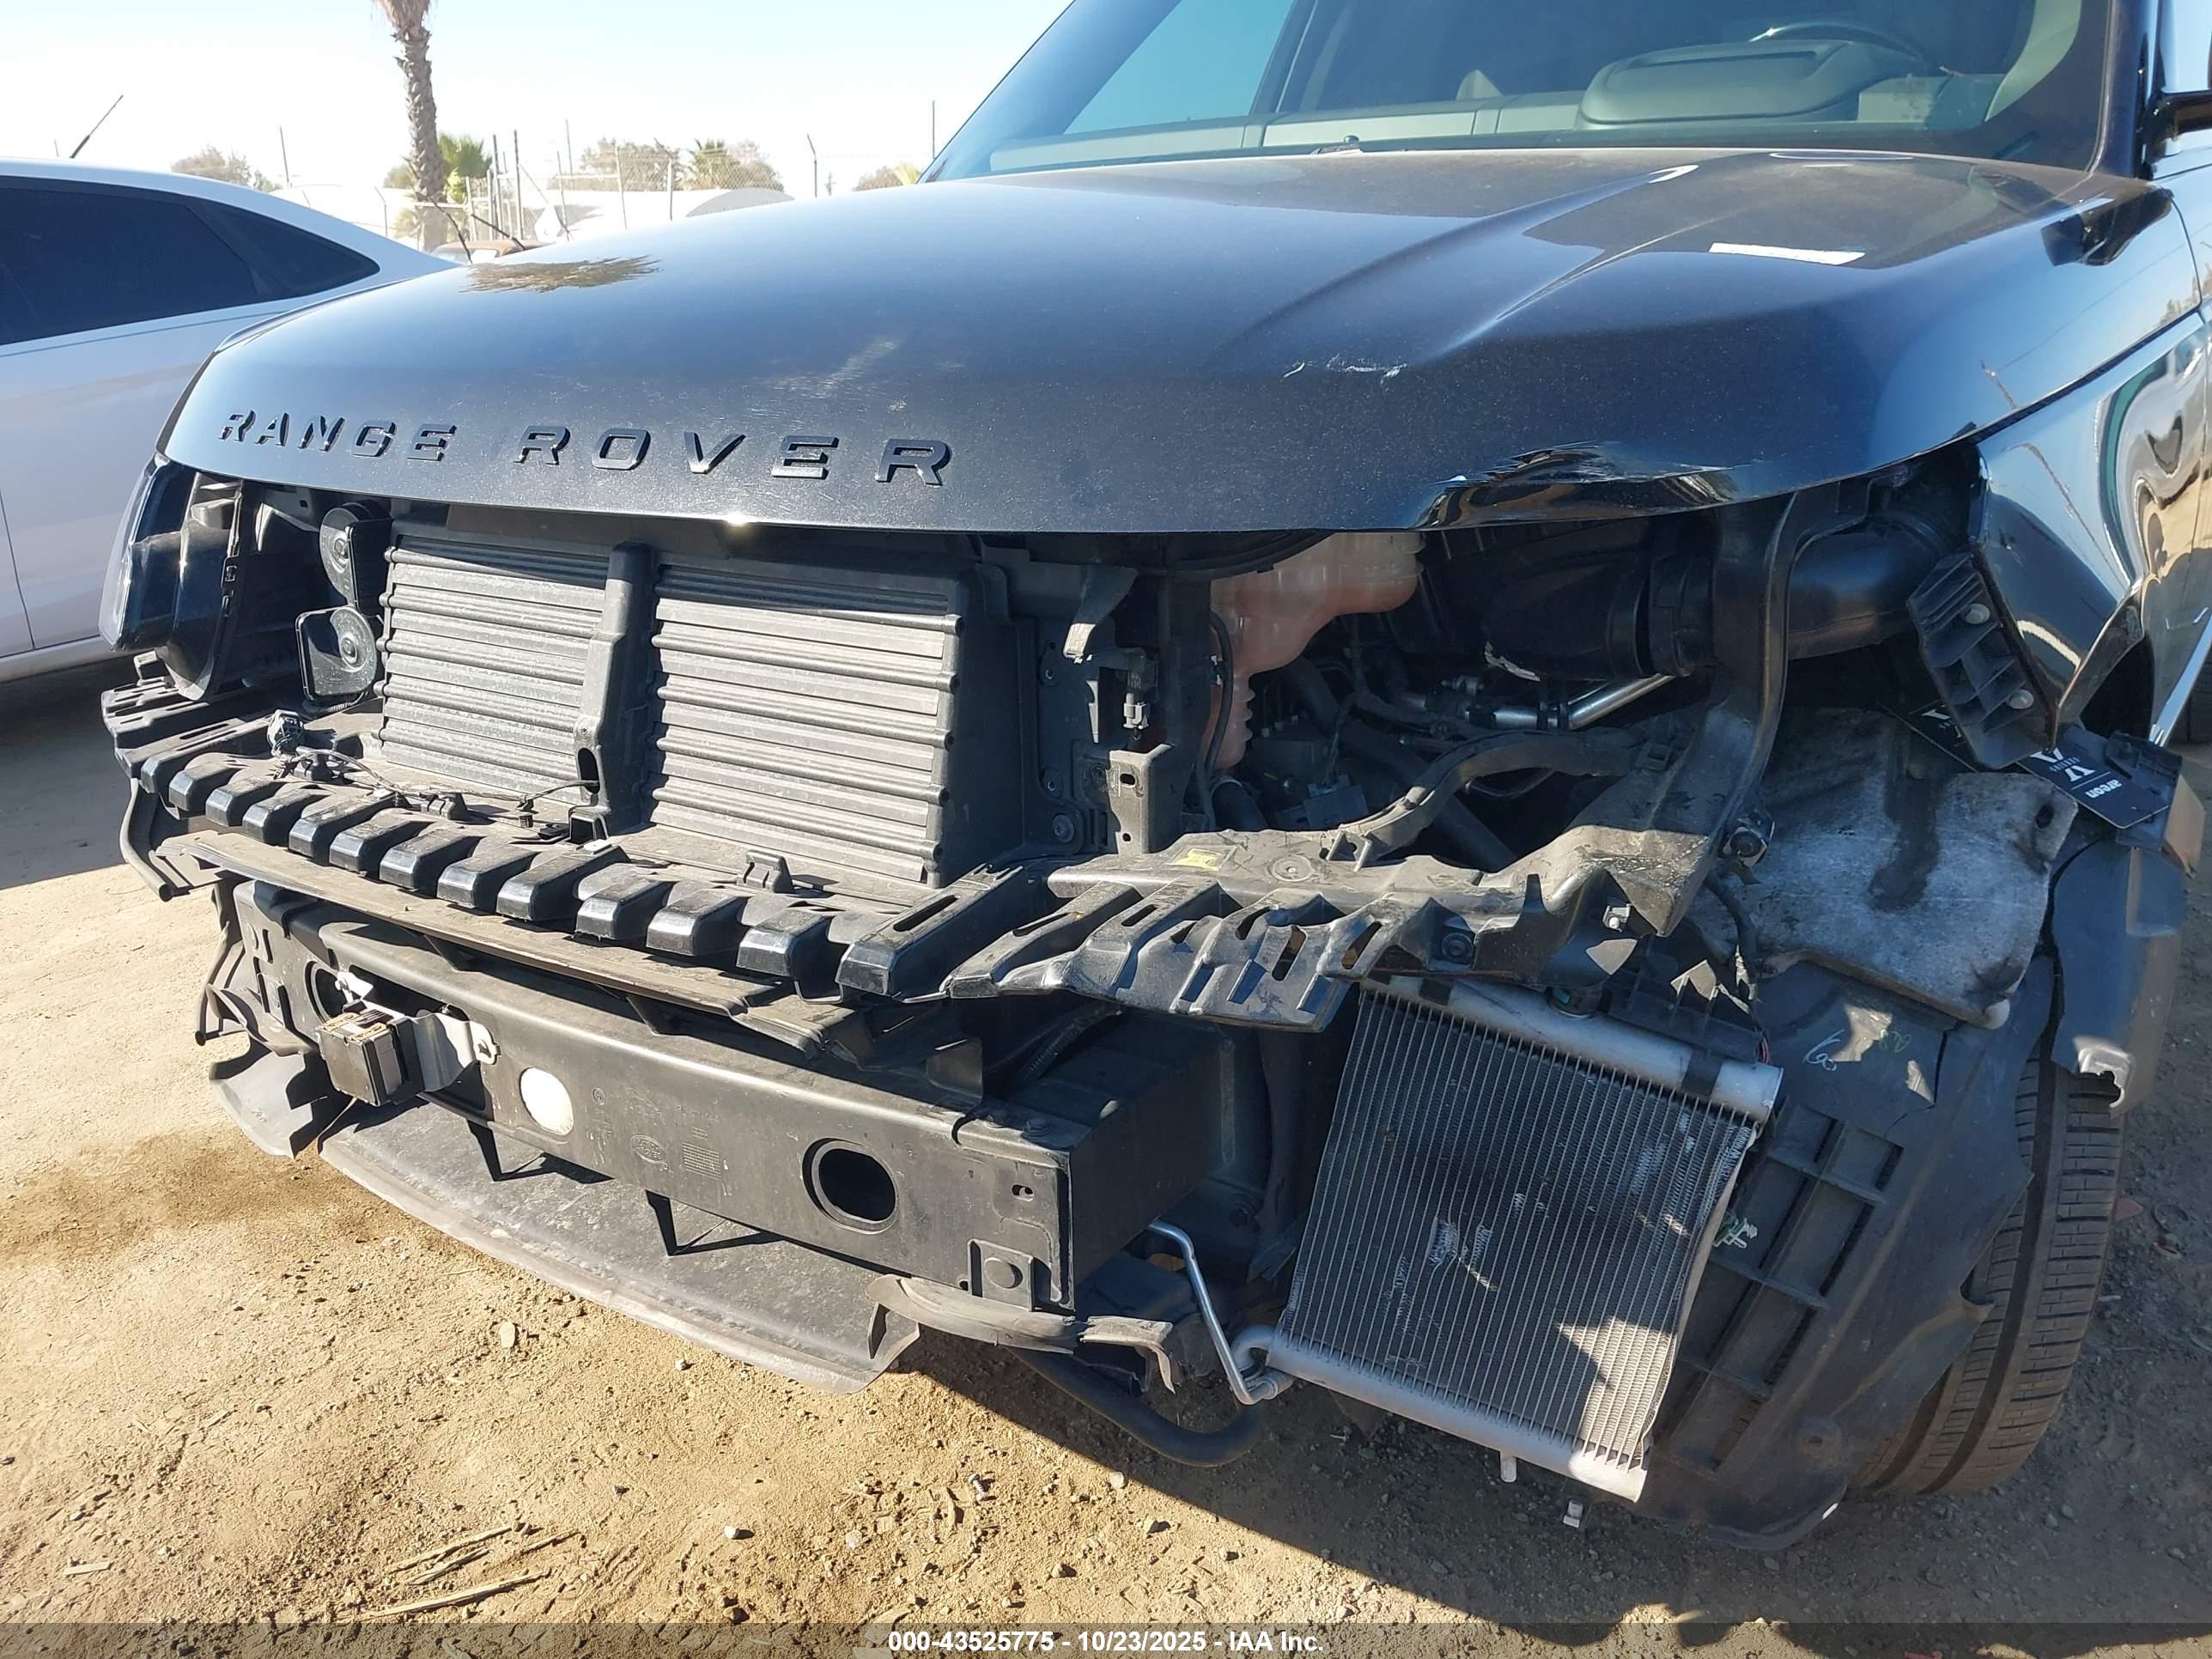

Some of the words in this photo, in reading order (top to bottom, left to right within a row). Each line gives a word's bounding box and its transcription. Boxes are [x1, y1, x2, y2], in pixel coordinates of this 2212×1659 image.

[219, 410, 458, 462] RANGE
[514, 425, 953, 486] ROVER
[2084, 779, 2124, 799] areon
